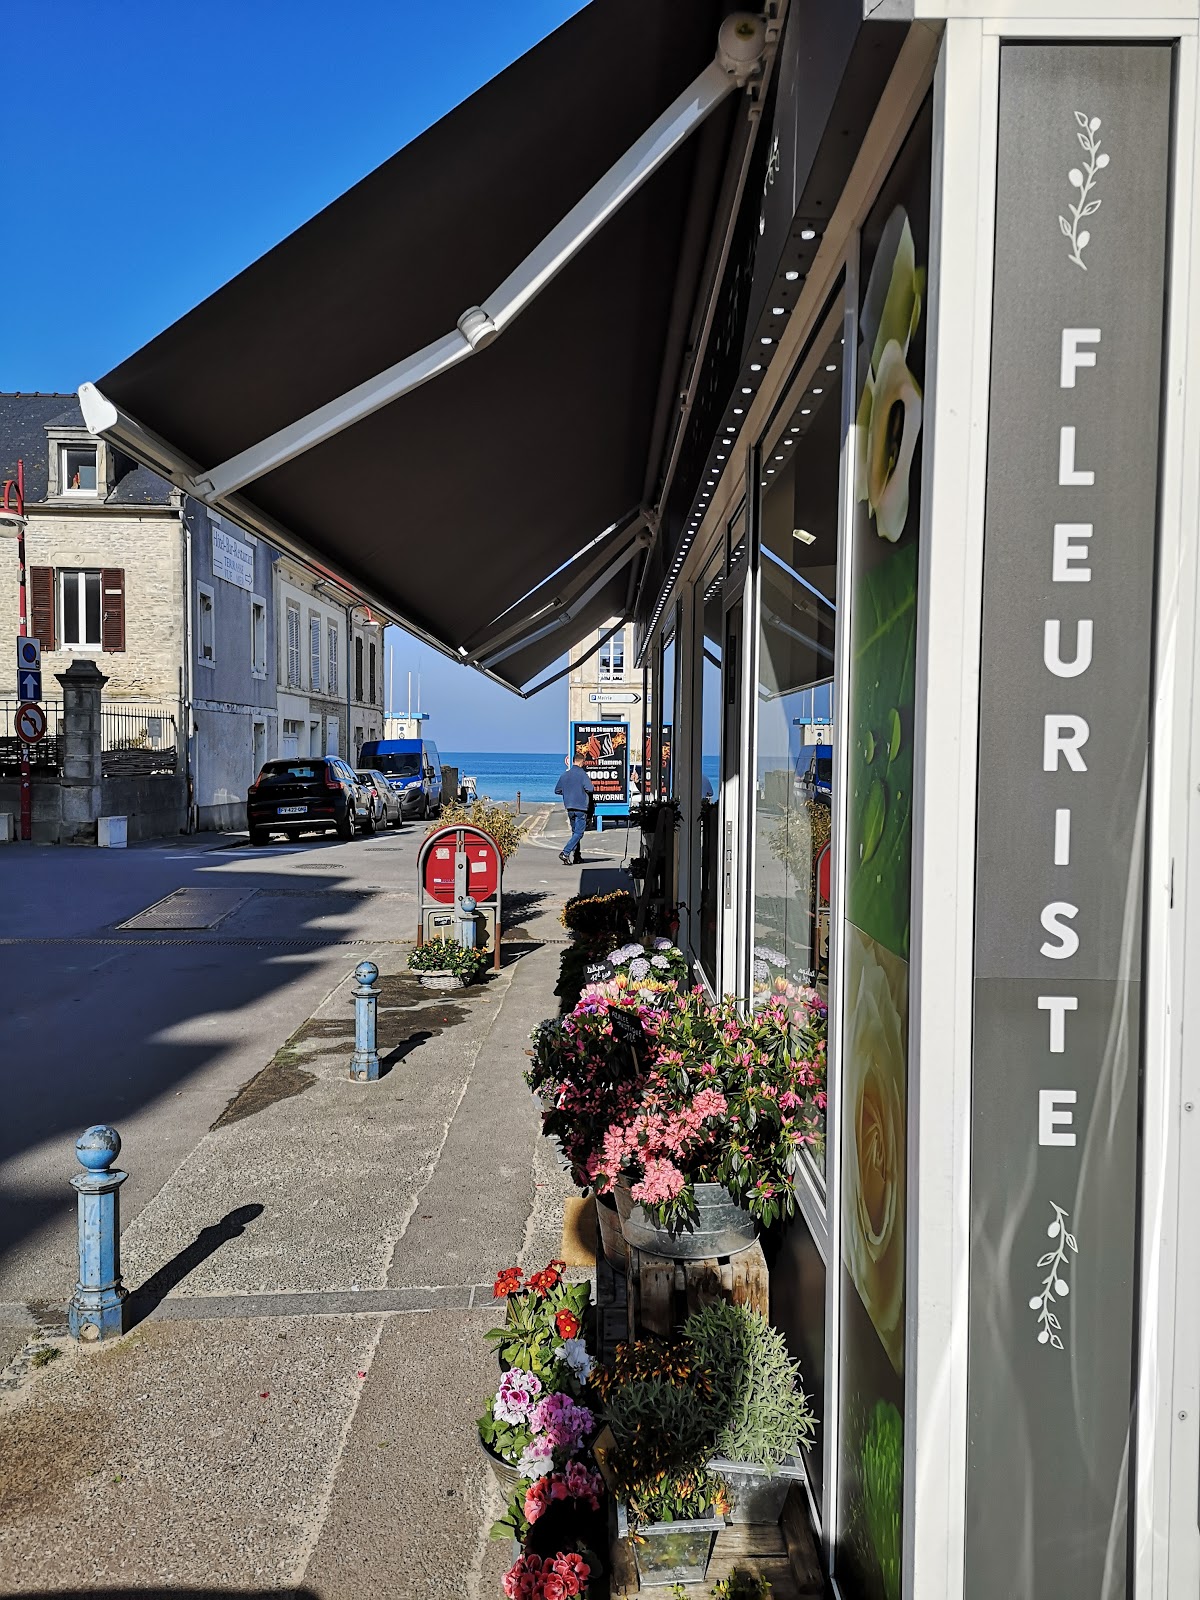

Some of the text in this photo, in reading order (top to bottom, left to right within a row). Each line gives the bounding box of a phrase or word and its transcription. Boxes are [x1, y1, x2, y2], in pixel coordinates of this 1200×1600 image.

[1037, 327, 1102, 1147] FLEURISTE
[610, 770, 618, 780] €
[592, 793, 624, 801] RY/ORNE
